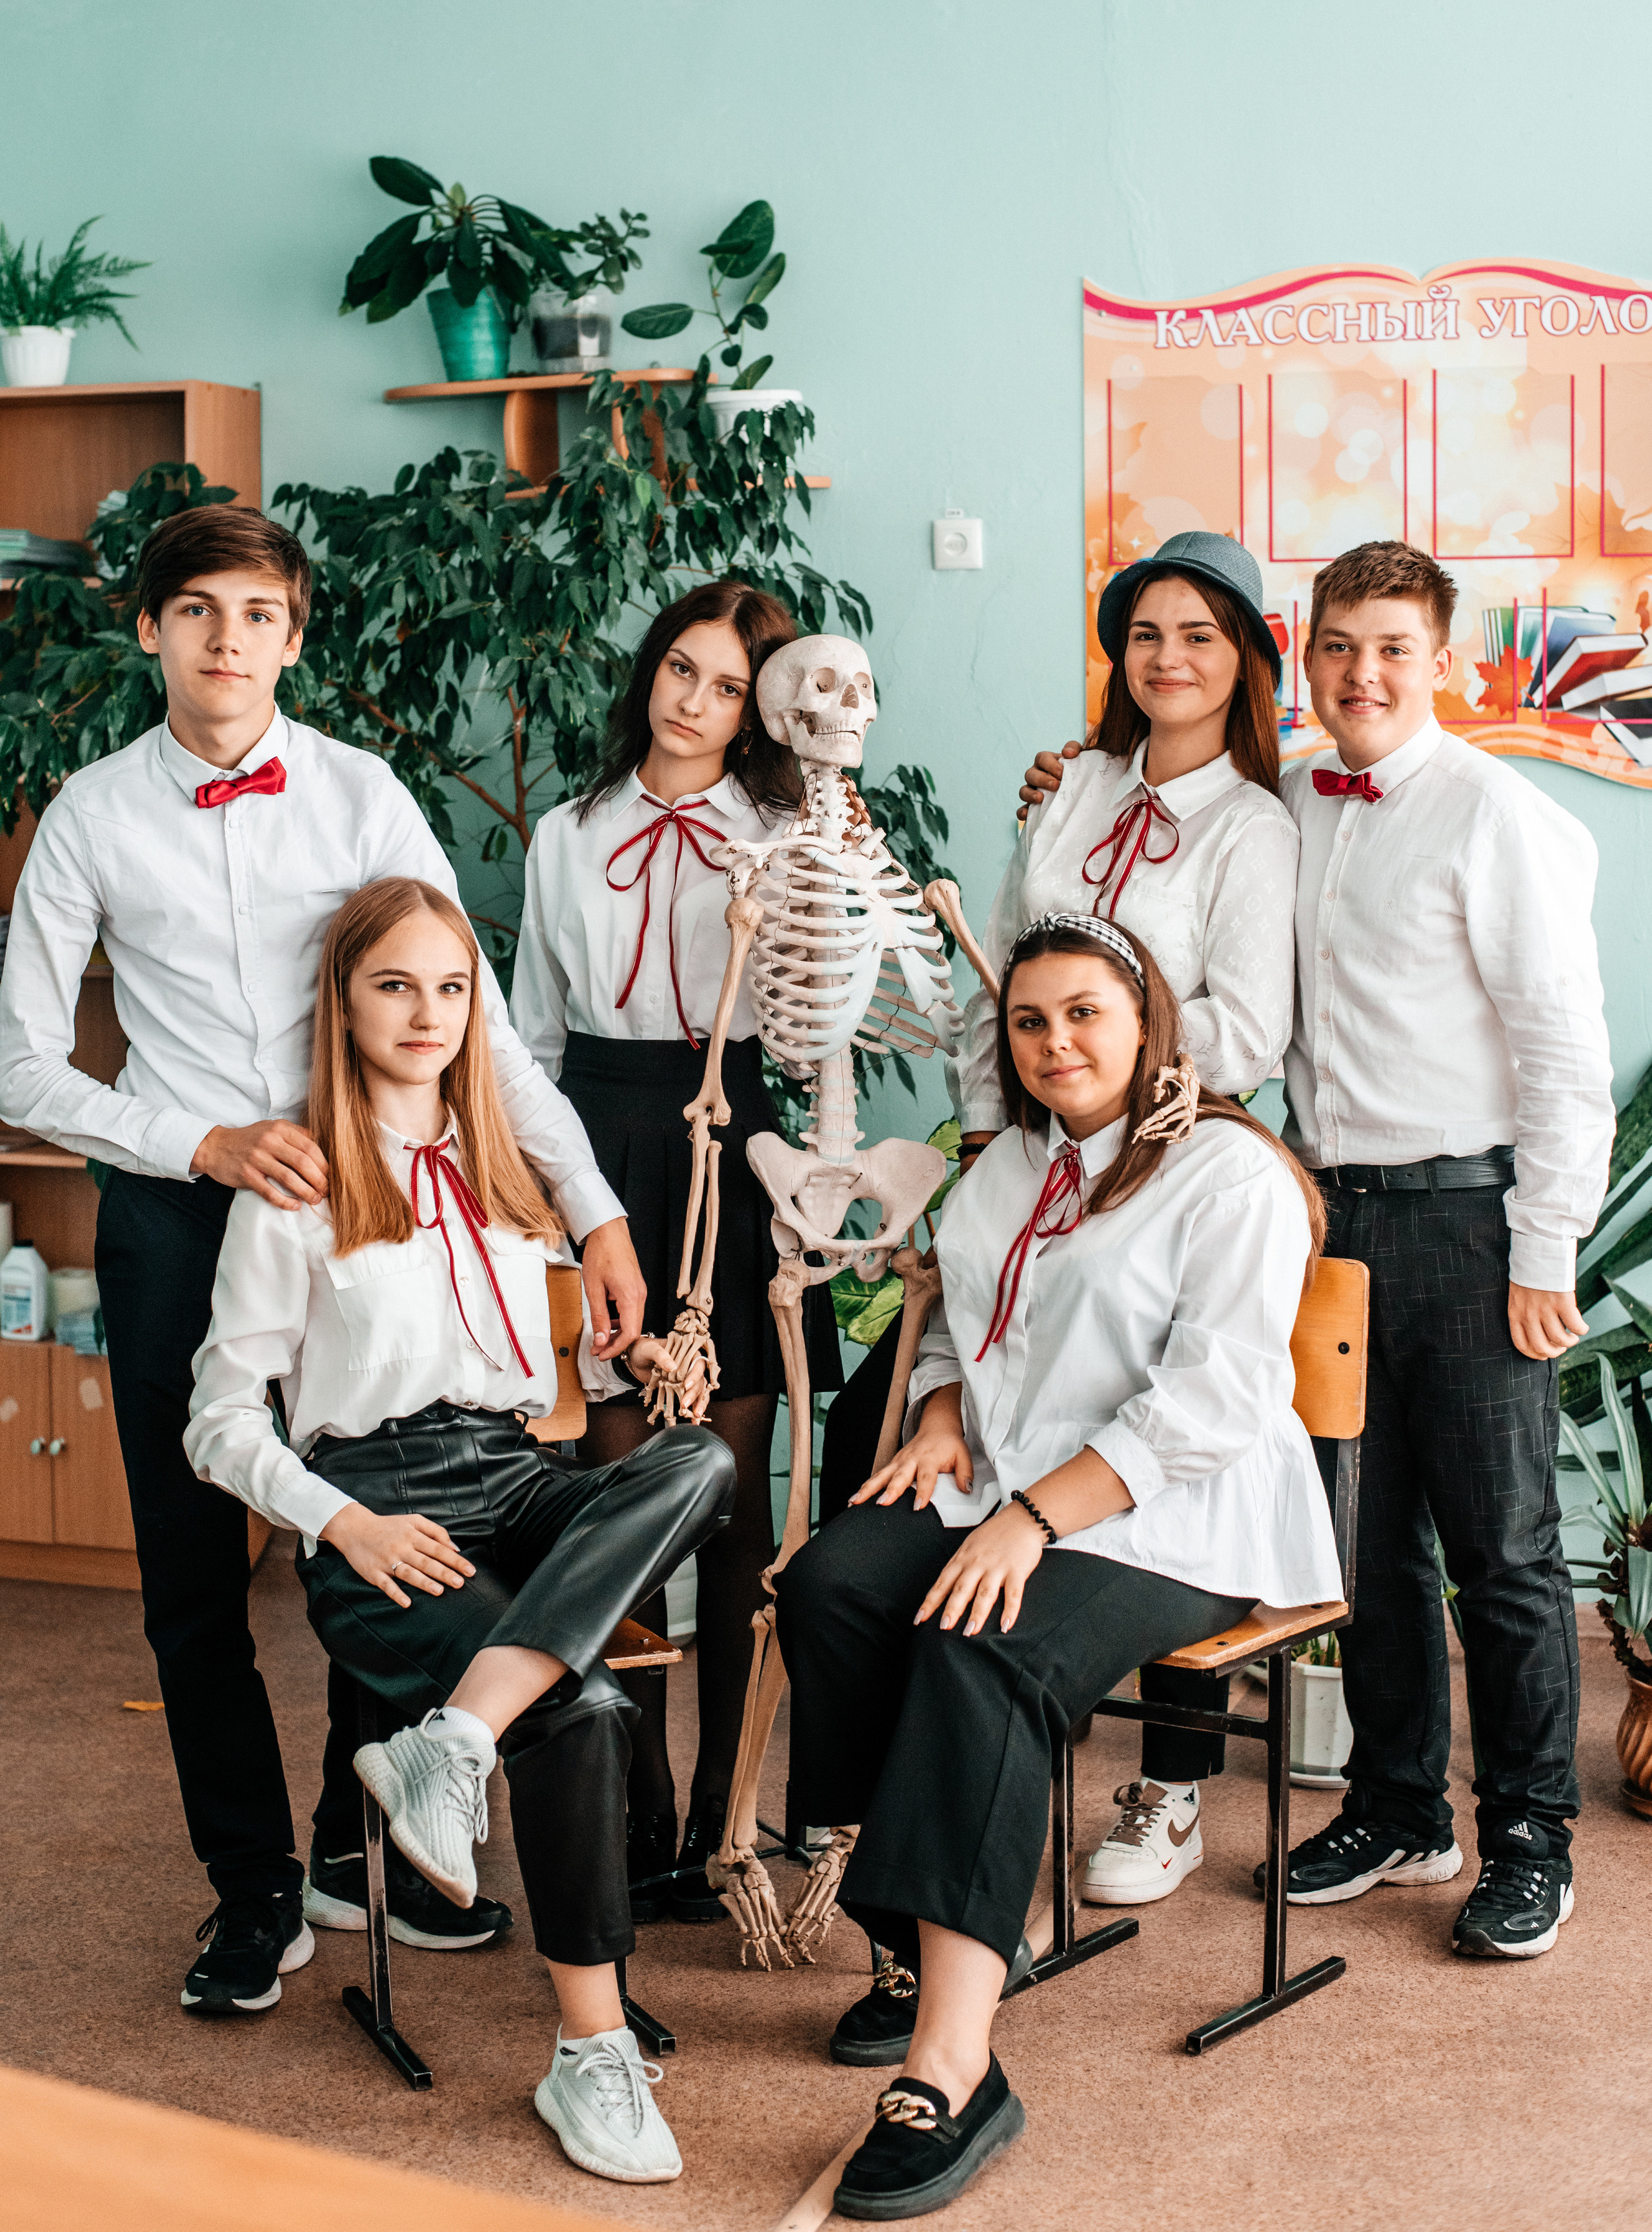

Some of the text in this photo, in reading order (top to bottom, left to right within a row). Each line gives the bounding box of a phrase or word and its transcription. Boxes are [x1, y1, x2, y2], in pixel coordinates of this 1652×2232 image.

[1154, 285, 1652, 349] КЛАССНЫЙ УГОЛО
[1508, 1827, 1533, 1840] adidas
